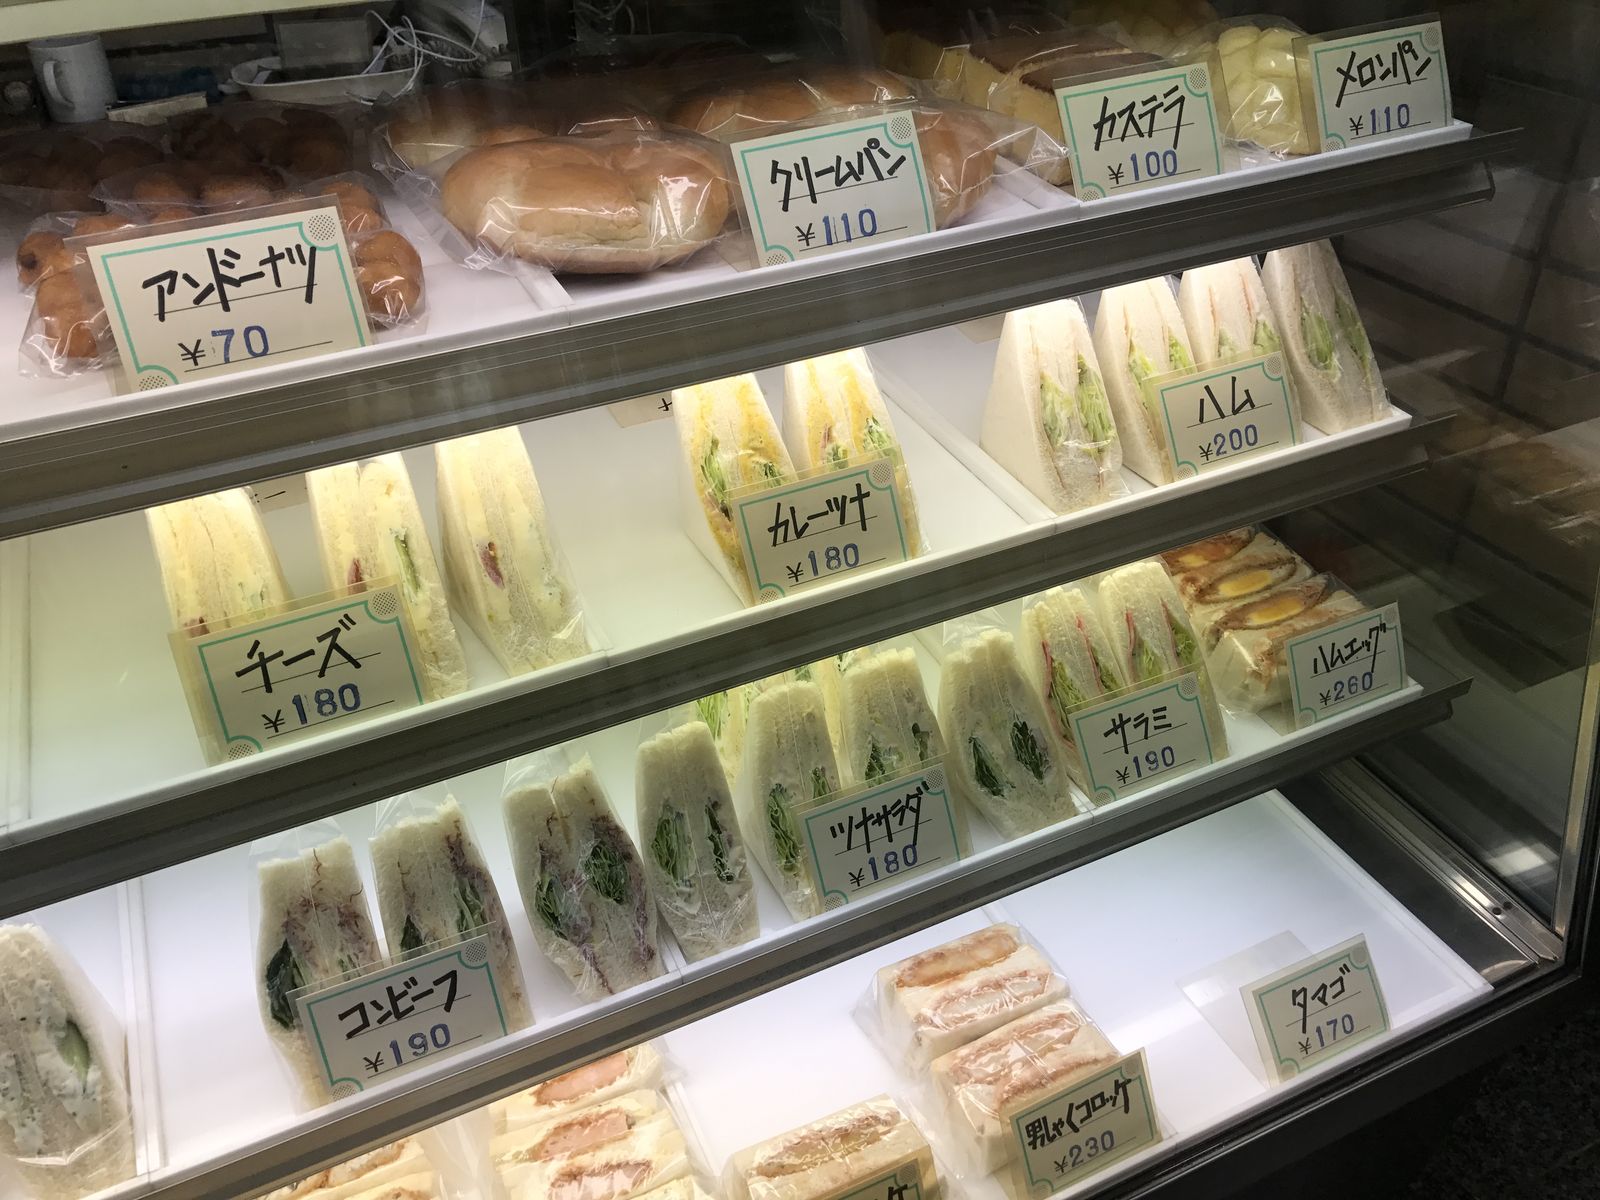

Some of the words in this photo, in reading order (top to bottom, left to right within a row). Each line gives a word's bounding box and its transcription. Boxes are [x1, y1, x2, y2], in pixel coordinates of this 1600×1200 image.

[1336, 40, 1432, 107] メロンパン
[1094, 85, 1186, 151] カステラ
[1349, 103, 1411, 136] ¥110
[770, 138, 906, 212] クリームパン
[1108, 150, 1178, 184] ¥100
[795, 208, 877, 246] ¥110
[142, 244, 316, 322] アンドーナツ
[178, 325, 270, 366] ¥70
[1199, 376, 1256, 424] ハム
[1199, 424, 1259, 462] ¥200
[767, 483, 871, 547] カレーツナ
[786, 543, 860, 582] ¥180
[235, 613, 361, 693] チーズ
[1312, 622, 1387, 674] ハムエッグ
[262, 683, 361, 733] ¥180
[1319, 672, 1374, 706] ¥260
[1103, 707, 1173, 754] サラミ
[1115, 746, 1175, 784] ¥190
[830, 781, 929, 853] ツナサラダ
[848, 844, 919, 887] ¥180
[338, 970, 458, 1041] コンビーフ
[1292, 964, 1351, 1033] タマゴ
[363, 1023, 451, 1073] ¥190
[1298, 1014, 1354, 1055] ¥170
[1025, 1079, 1132, 1150] 男しゃくコロッケ
[1054, 1131, 1115, 1173] ¥230
